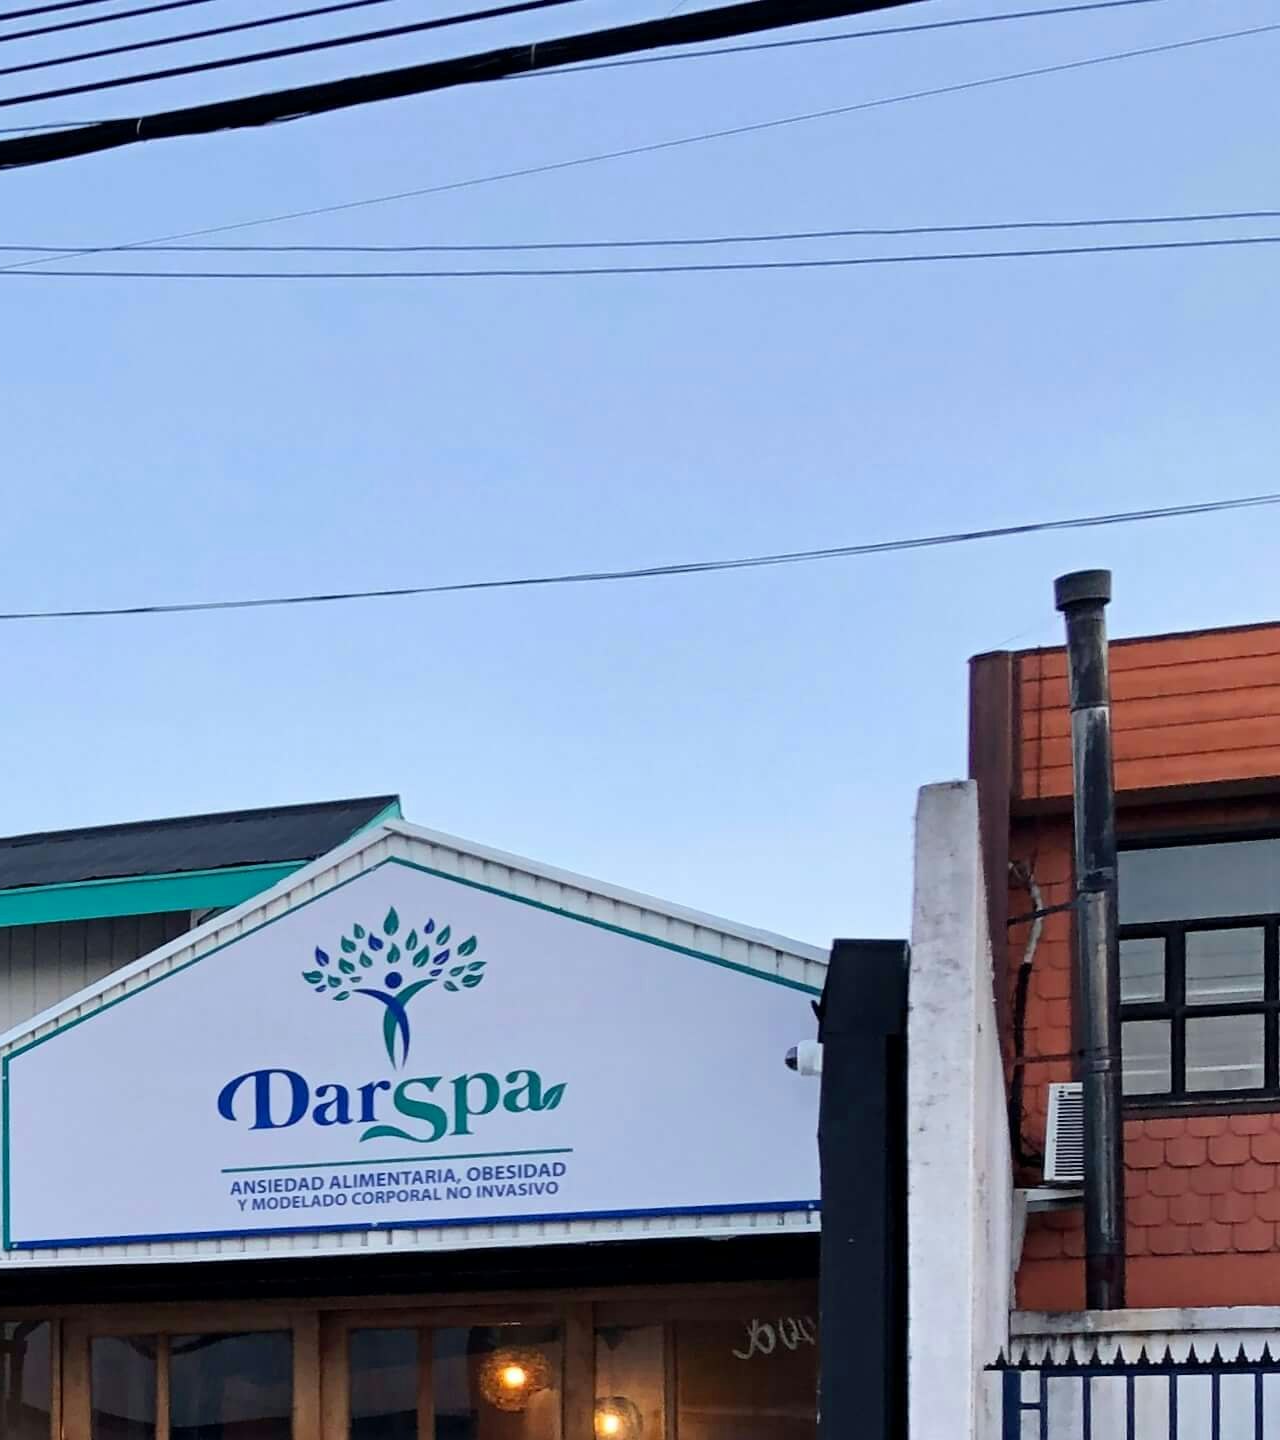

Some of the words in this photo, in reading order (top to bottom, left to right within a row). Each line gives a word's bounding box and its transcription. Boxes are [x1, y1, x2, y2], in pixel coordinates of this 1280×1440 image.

[217, 1067, 567, 1143] DarSpa
[230, 1176, 325, 1196] ANSIEDAD
[329, 1169, 462, 1191] ALIMENTARIA,
[467, 1162, 566, 1182] OBESIDAD
[238, 1200, 248, 1211] Y
[252, 1194, 347, 1211] MODELADO
[351, 1188, 442, 1206] CORPORAL
[446, 1185, 472, 1200] NO
[477, 1181, 559, 1198] INVASIVO
